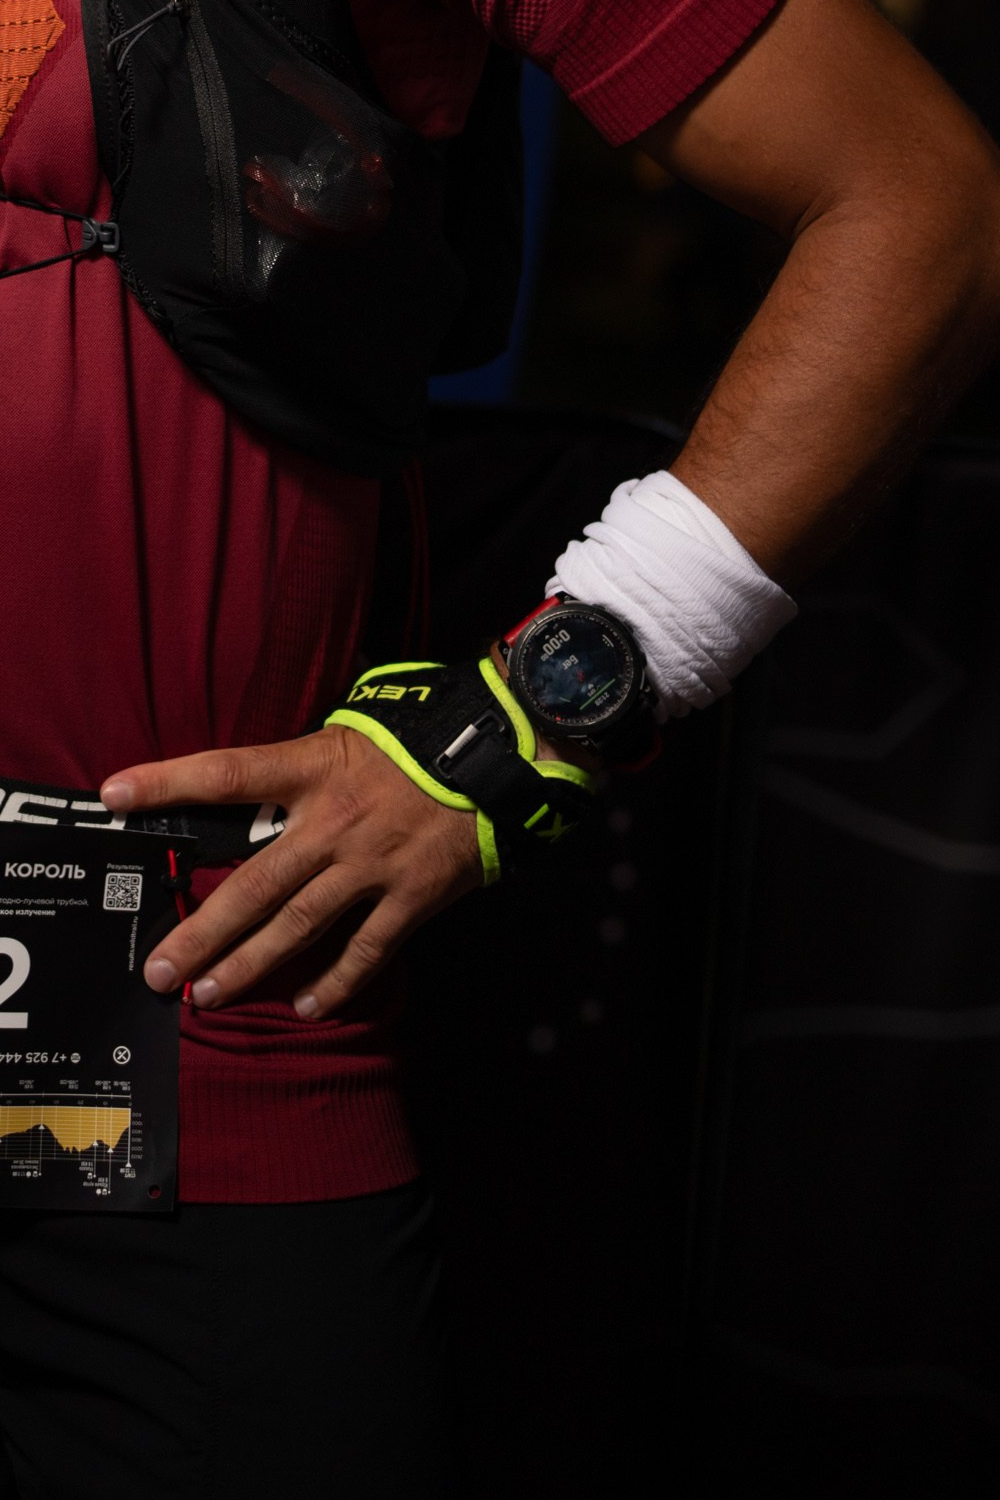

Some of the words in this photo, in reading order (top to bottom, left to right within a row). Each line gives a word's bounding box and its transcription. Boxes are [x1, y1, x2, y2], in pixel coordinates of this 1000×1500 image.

[346, 685, 432, 704] LEKI
[3, 861, 87, 880] КОРОЛЬ
[15, 908, 57, 918] излучение
[25, 1052, 49, 1063] 925
[51, 1052, 67, 1063] +7
